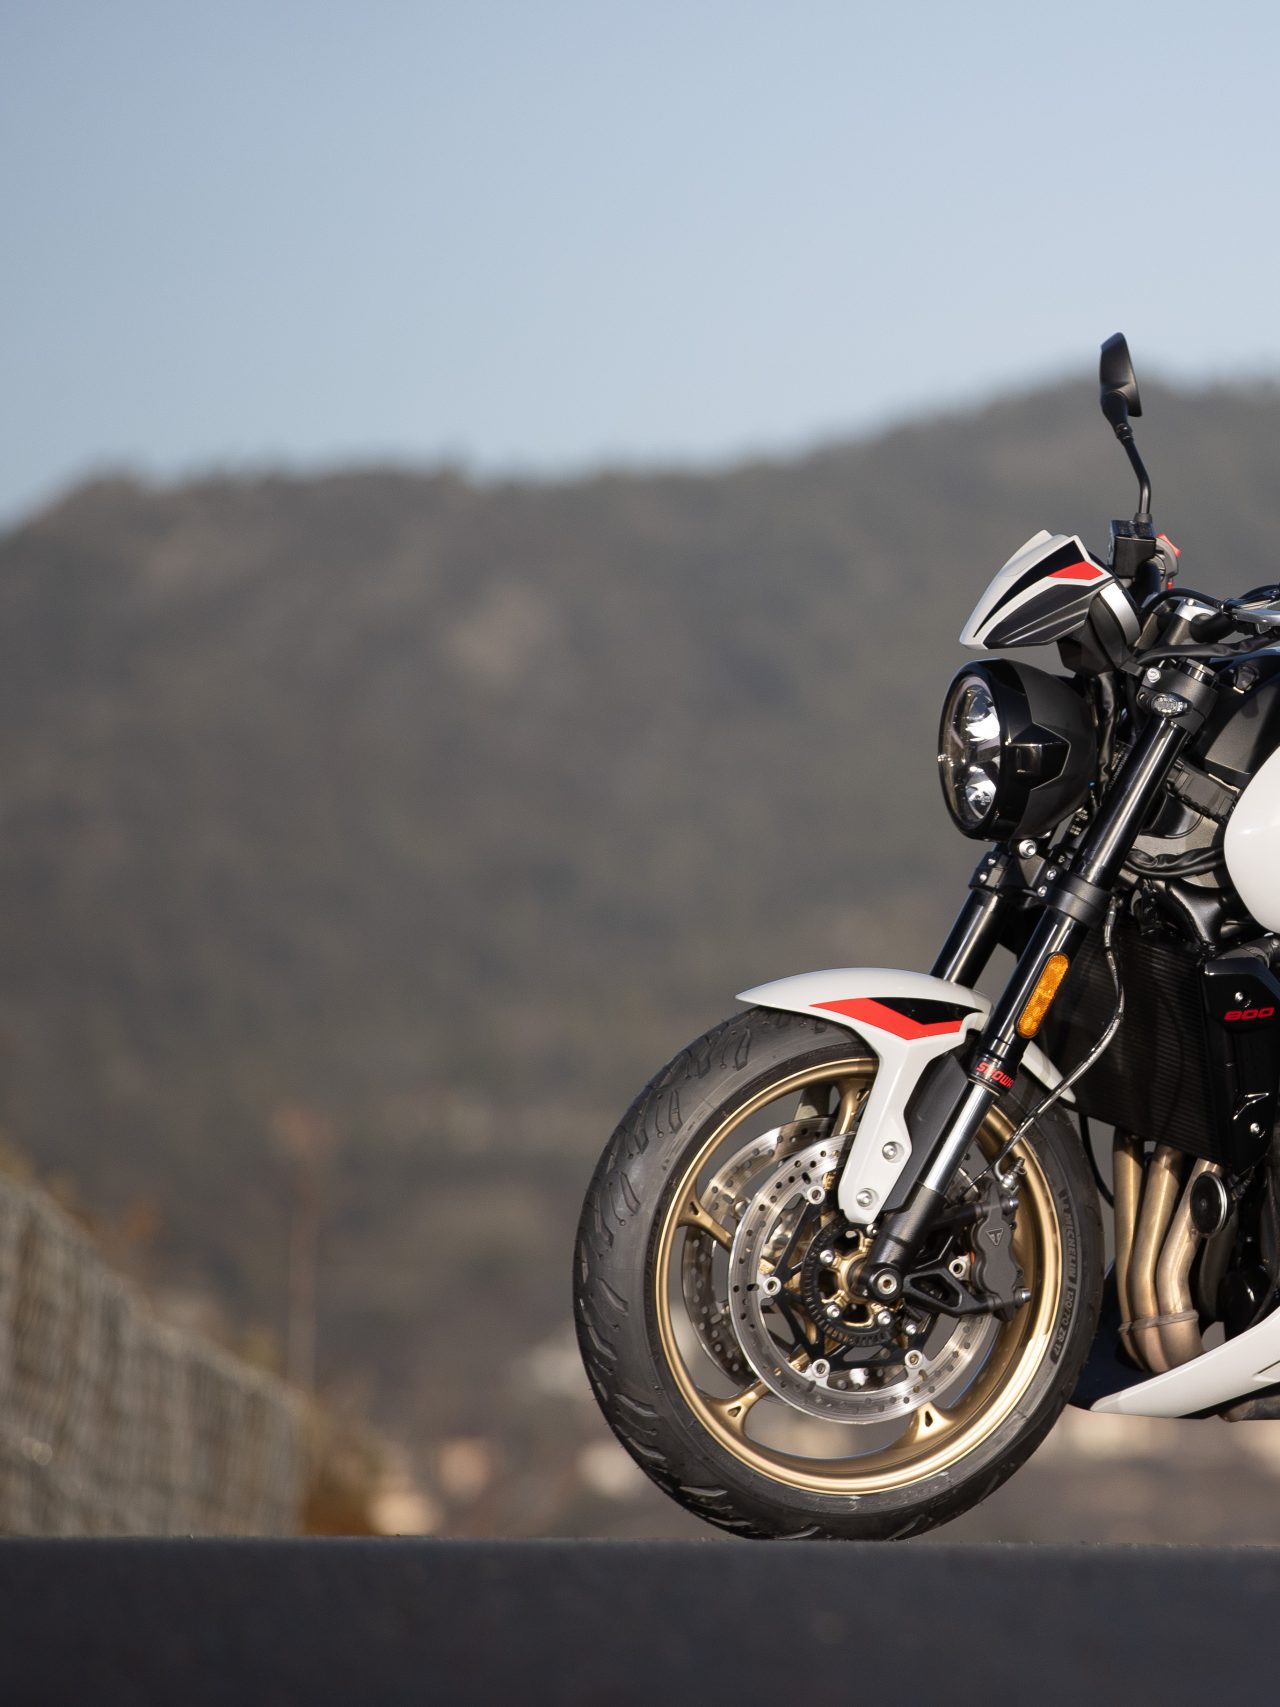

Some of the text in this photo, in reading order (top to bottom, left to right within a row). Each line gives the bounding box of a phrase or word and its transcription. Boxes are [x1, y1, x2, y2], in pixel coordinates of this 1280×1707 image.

[1224, 1007, 1275, 1020] 800
[1064, 1212, 1076, 1278] MICHELIN
[1061, 1289, 1074, 1325] 120/70
